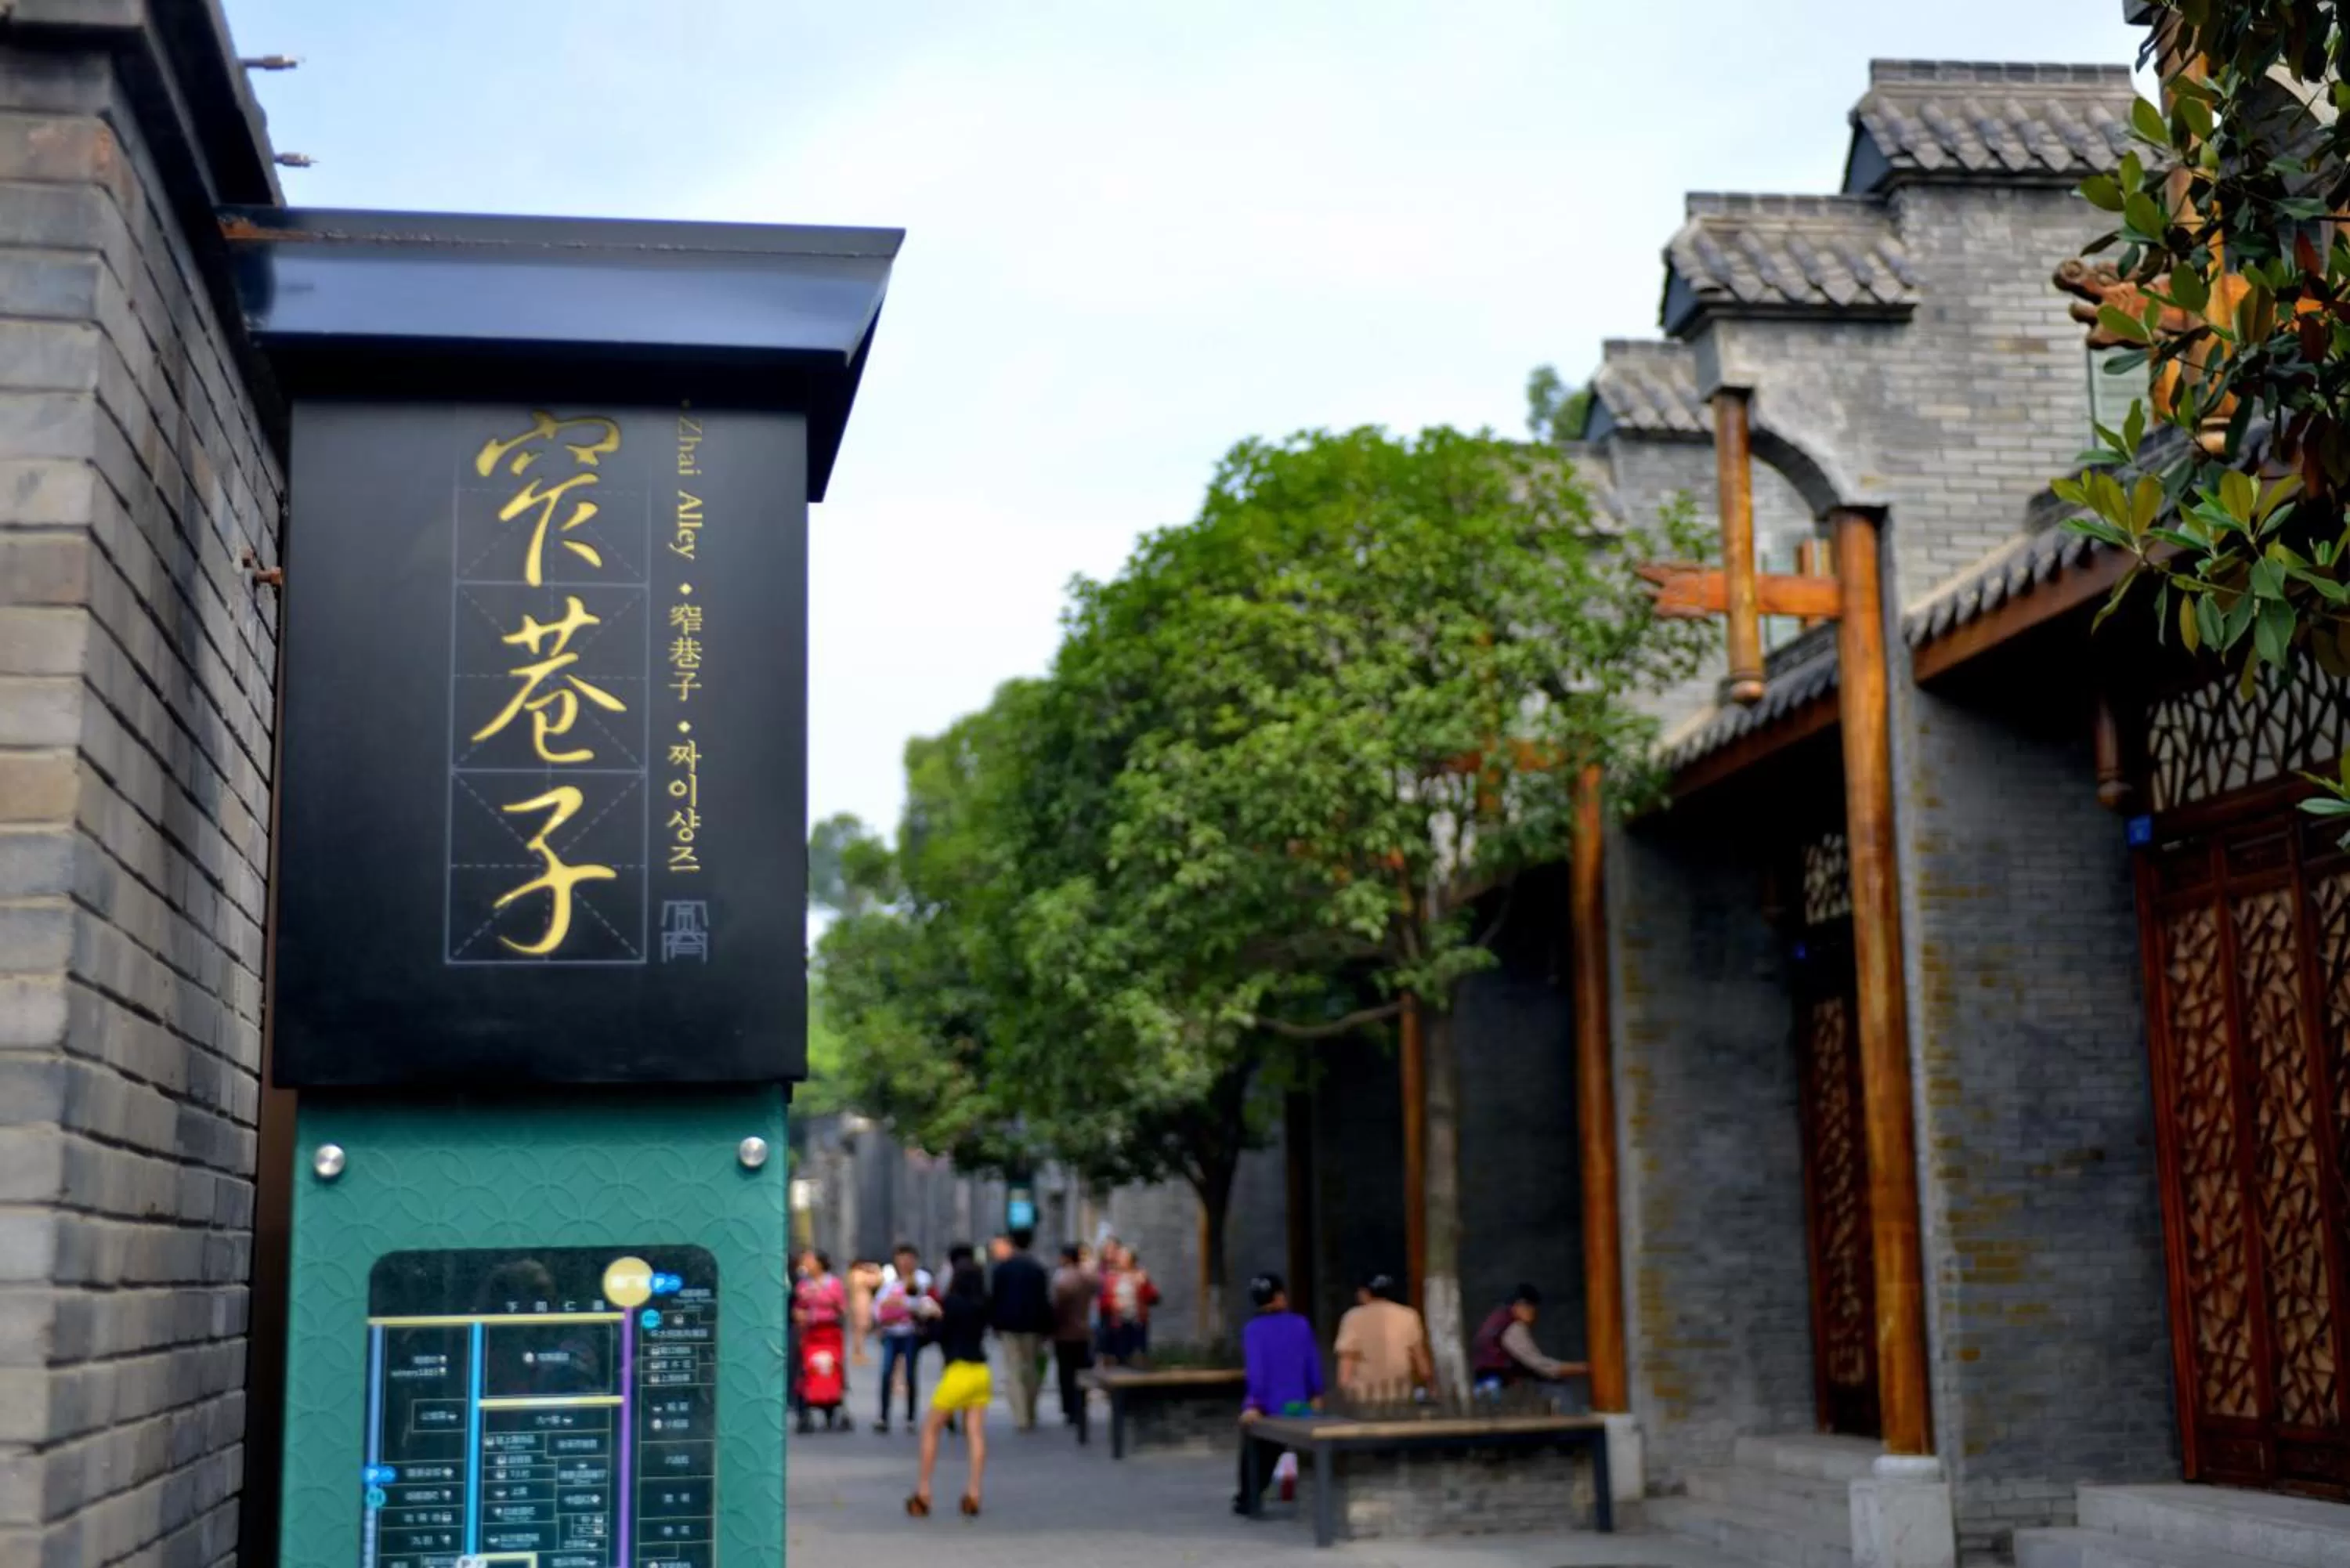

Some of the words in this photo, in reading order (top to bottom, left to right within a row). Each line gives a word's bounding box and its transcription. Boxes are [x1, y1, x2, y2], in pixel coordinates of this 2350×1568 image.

[676, 417, 703, 476] Zhai
[668, 489, 703, 561] Alley
[472, 410, 627, 956] 窄巷子
[668, 602, 703, 702] 窄巷子
[667, 739, 703, 873] 짜이샹즈
